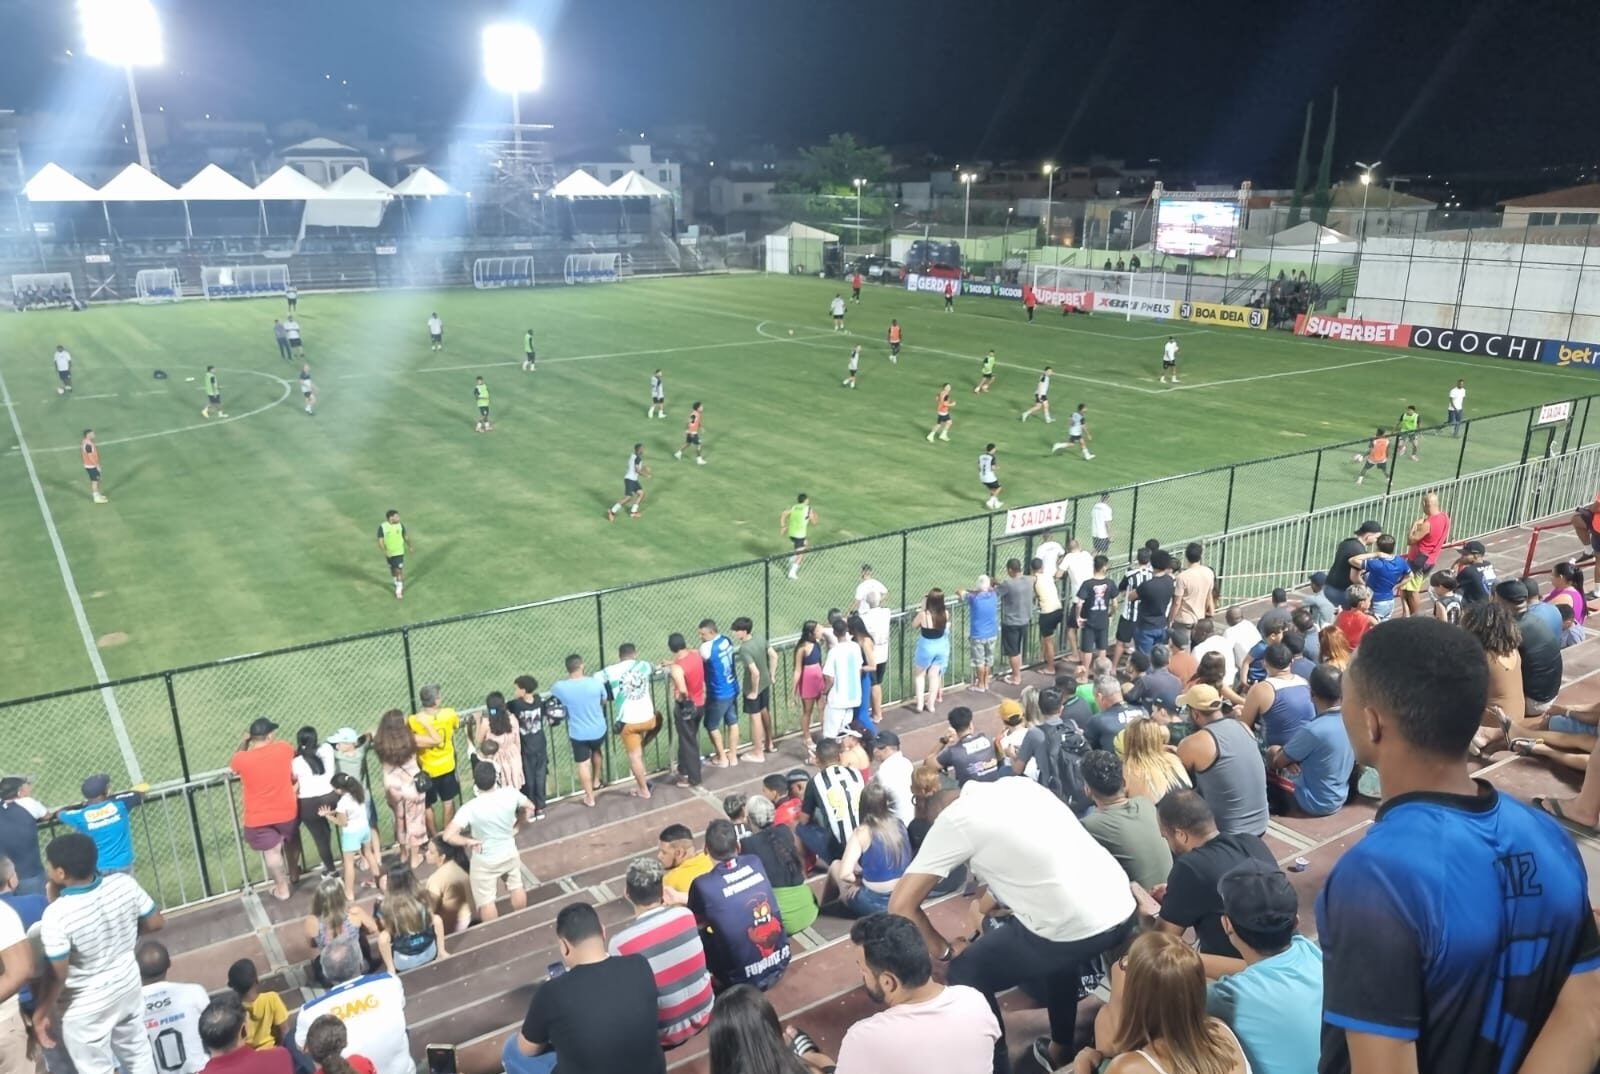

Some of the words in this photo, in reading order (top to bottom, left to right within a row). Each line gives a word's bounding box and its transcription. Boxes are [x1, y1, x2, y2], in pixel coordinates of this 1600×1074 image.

[969, 284, 991, 294] SICOOB
[999, 287, 1022, 298] SICOOB
[1195, 308, 1217, 320] BOA
[1219, 310, 1245, 323] IDEIA
[1250, 313, 1263, 328] 51
[1306, 316, 1398, 342] SUPERBET
[1413, 327, 1543, 361] OGOCHI
